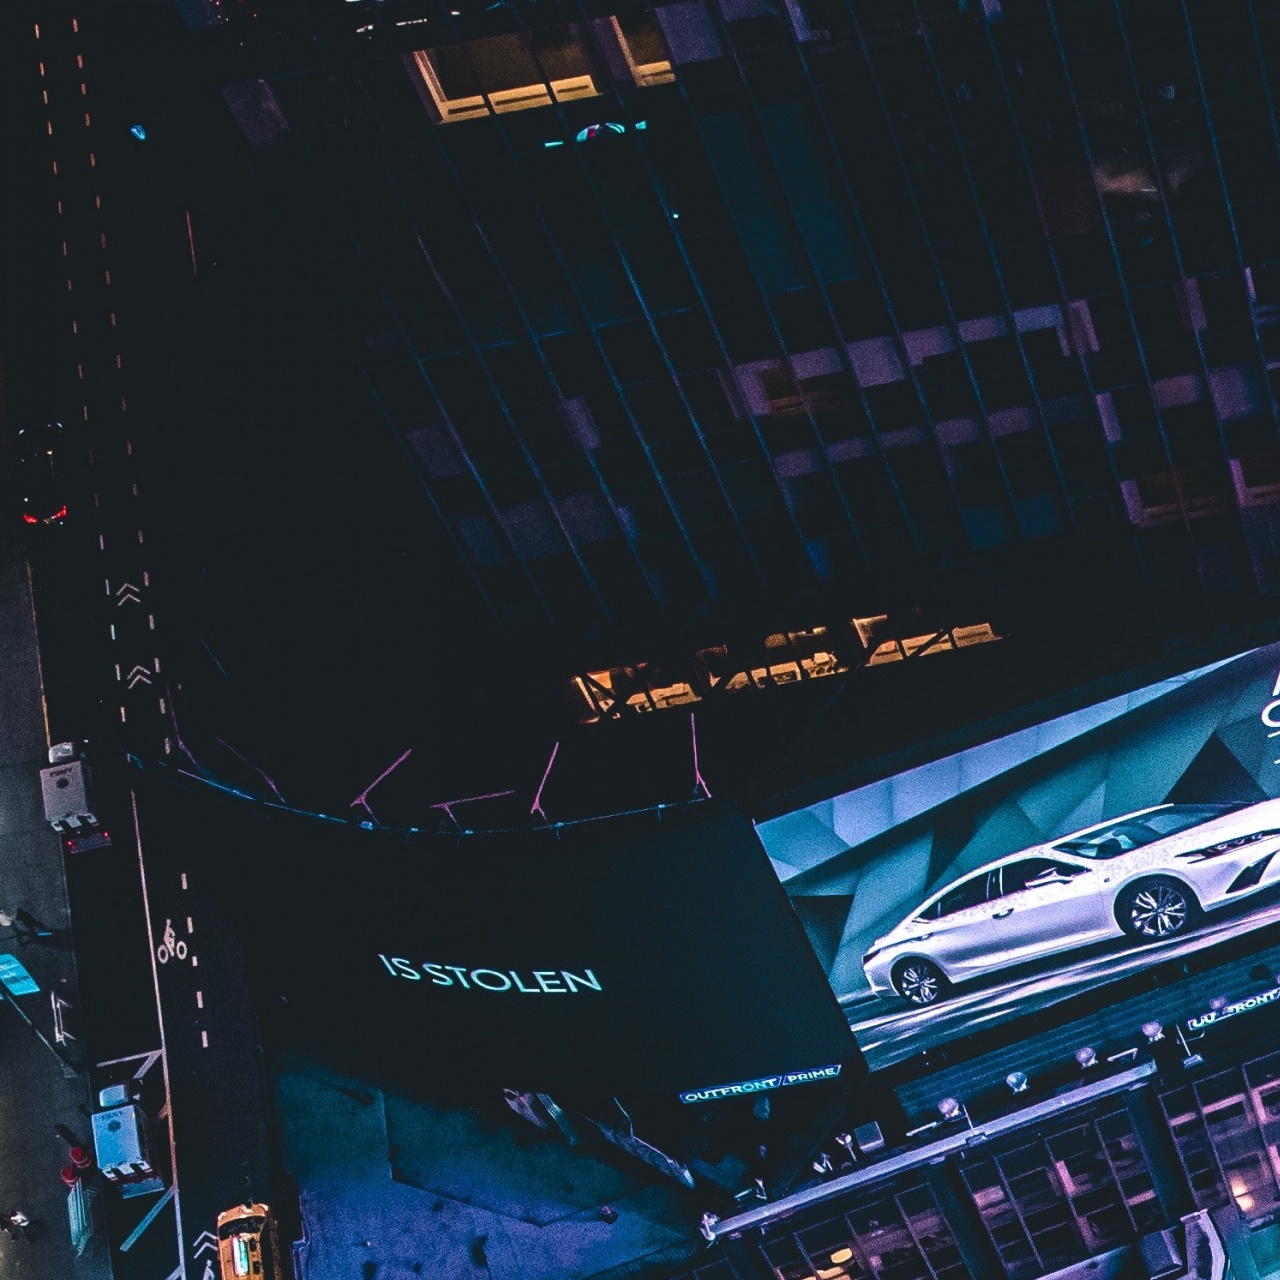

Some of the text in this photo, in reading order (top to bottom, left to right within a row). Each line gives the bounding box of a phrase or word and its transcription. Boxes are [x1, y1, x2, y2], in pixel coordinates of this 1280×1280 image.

[378, 954, 603, 993] IS STOLEN
[685, 1067, 835, 1101] OUTFRONT PRIME
